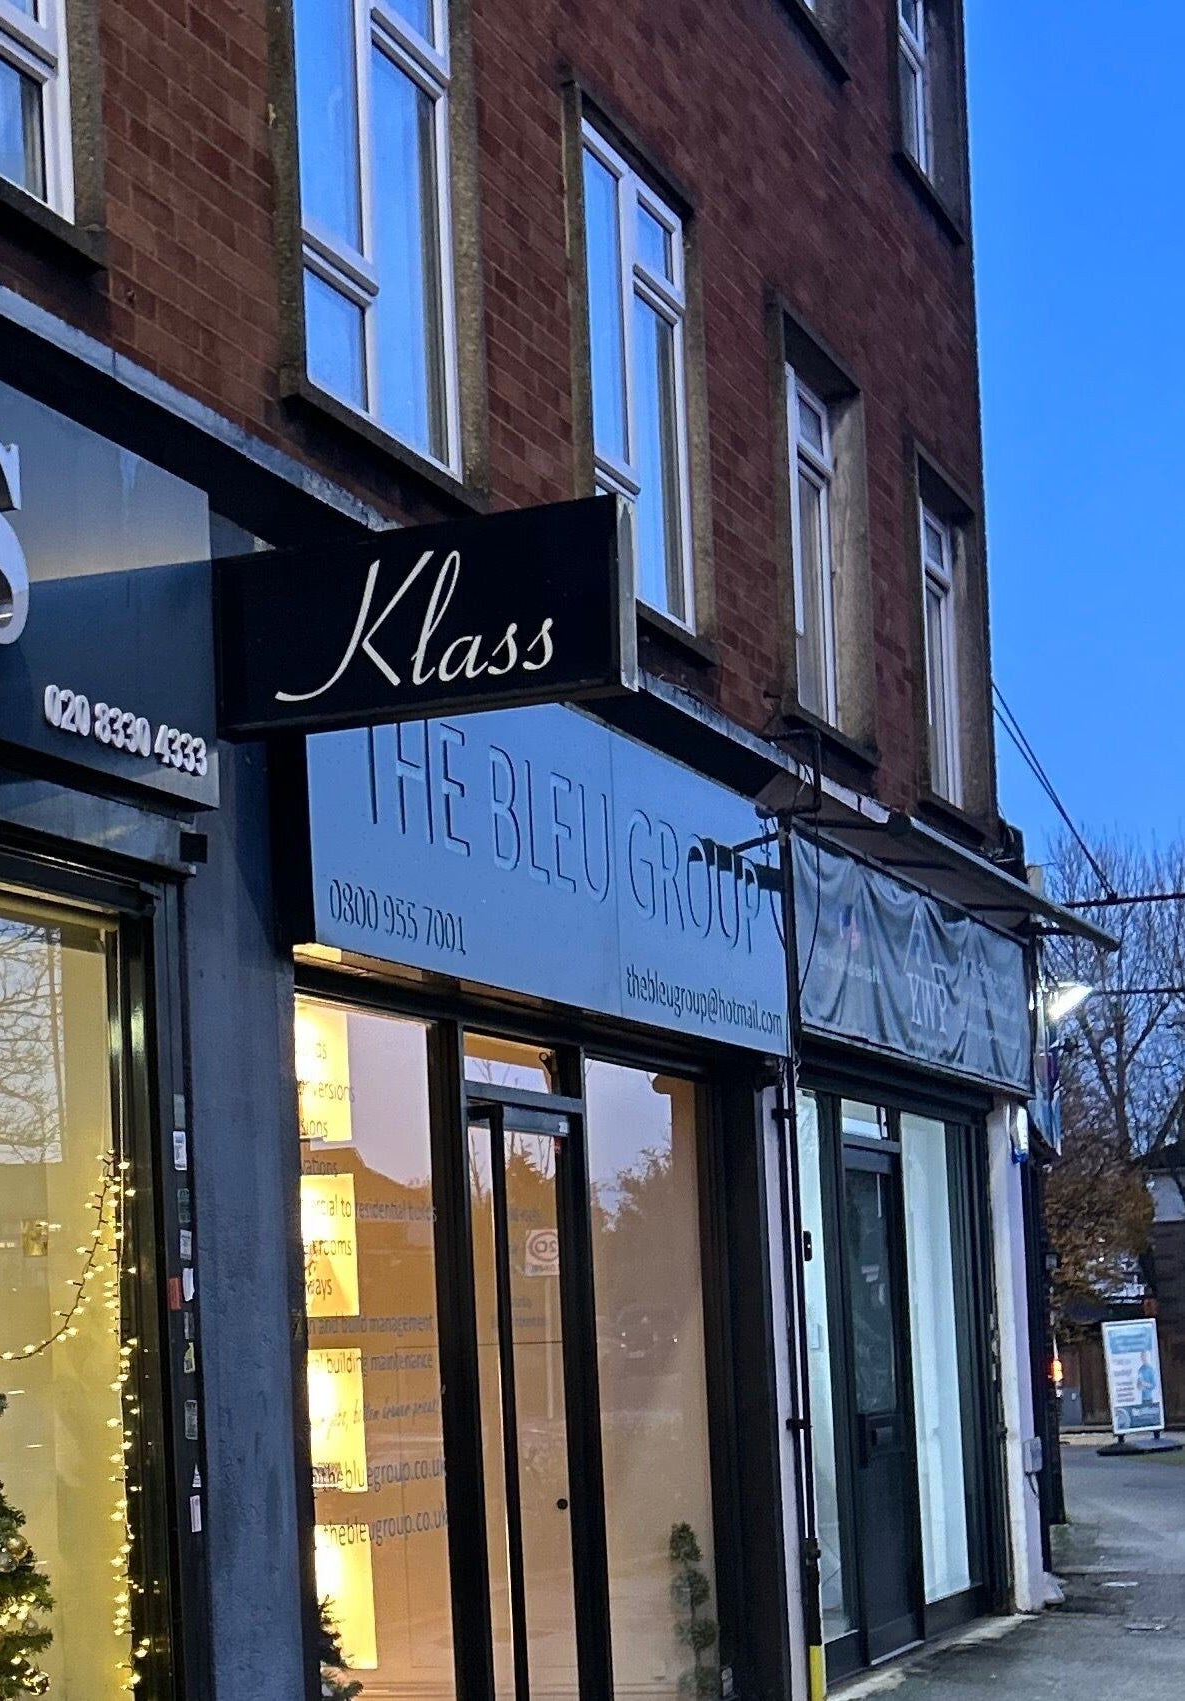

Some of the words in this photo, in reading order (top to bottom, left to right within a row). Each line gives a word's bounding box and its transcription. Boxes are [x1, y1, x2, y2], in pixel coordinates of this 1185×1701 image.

[275, 550, 553, 701] Klass
[44, 684, 90, 736] 020
[94, 702, 151, 757] 8330
[154, 724, 208, 776] 4333
[368, 719, 470, 857] THE
[490, 744, 610, 903] BLEU
[628, 809, 760, 953] GROUP
[330, 879, 378, 931] 0800
[384, 895, 418, 940] 955
[423, 906, 466, 955] 7001
[626, 964, 782, 1036] thebleugroup@hotmail.com
